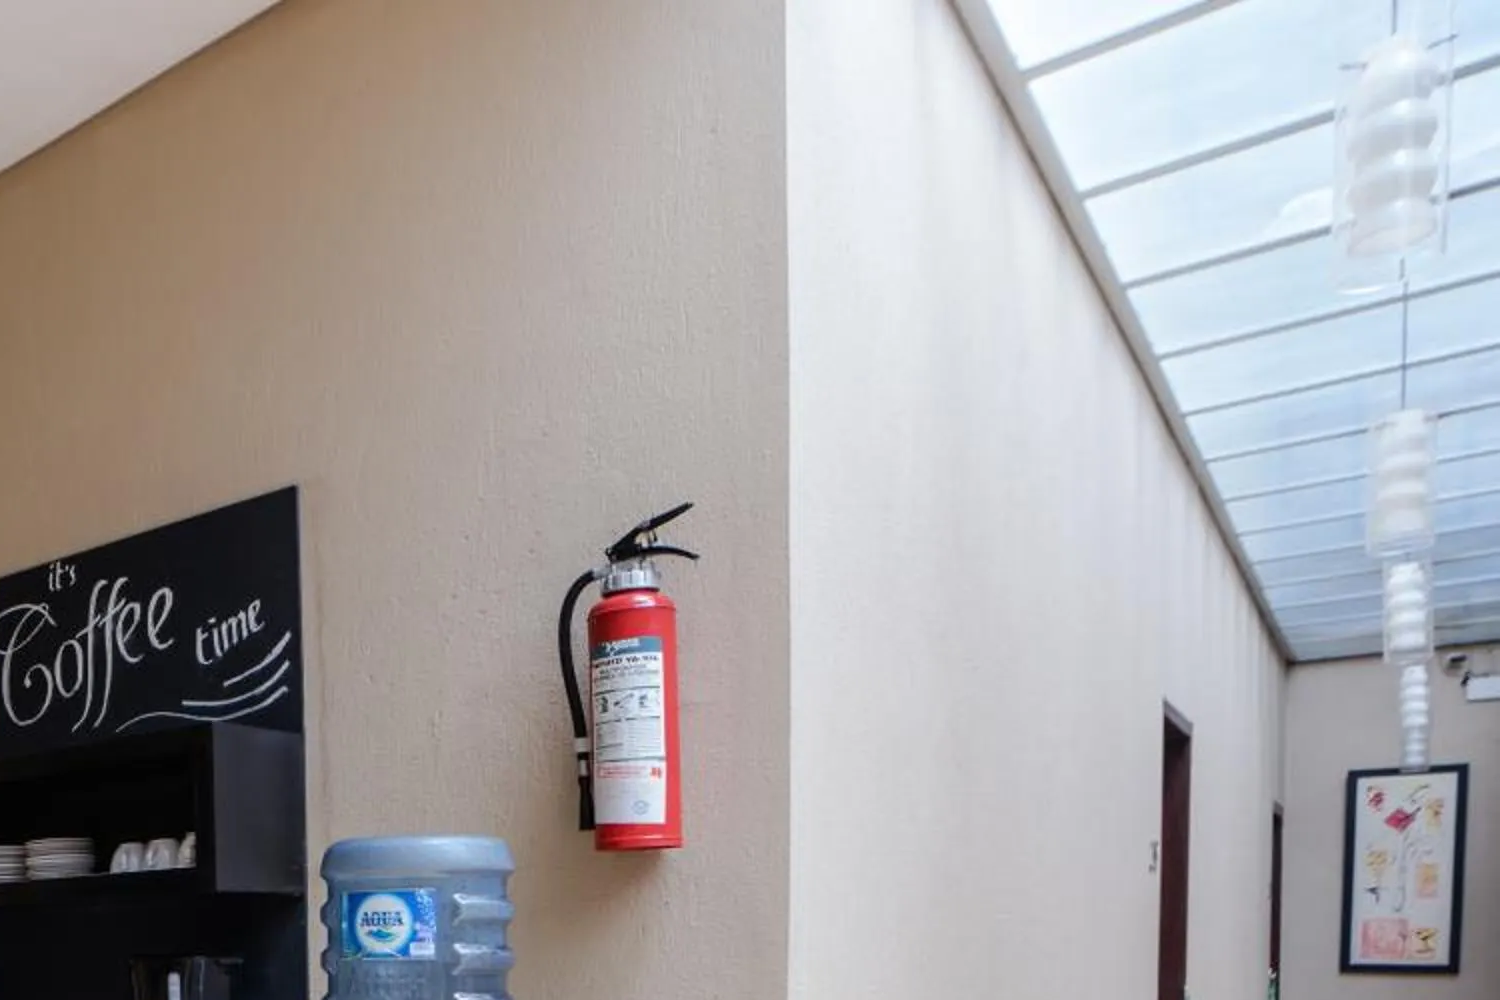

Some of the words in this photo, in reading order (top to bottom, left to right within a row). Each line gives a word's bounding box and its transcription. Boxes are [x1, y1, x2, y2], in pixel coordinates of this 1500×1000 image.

[48, 560, 77, 592] it's
[195, 598, 266, 666] time
[361, 911, 404, 927] AQUA
